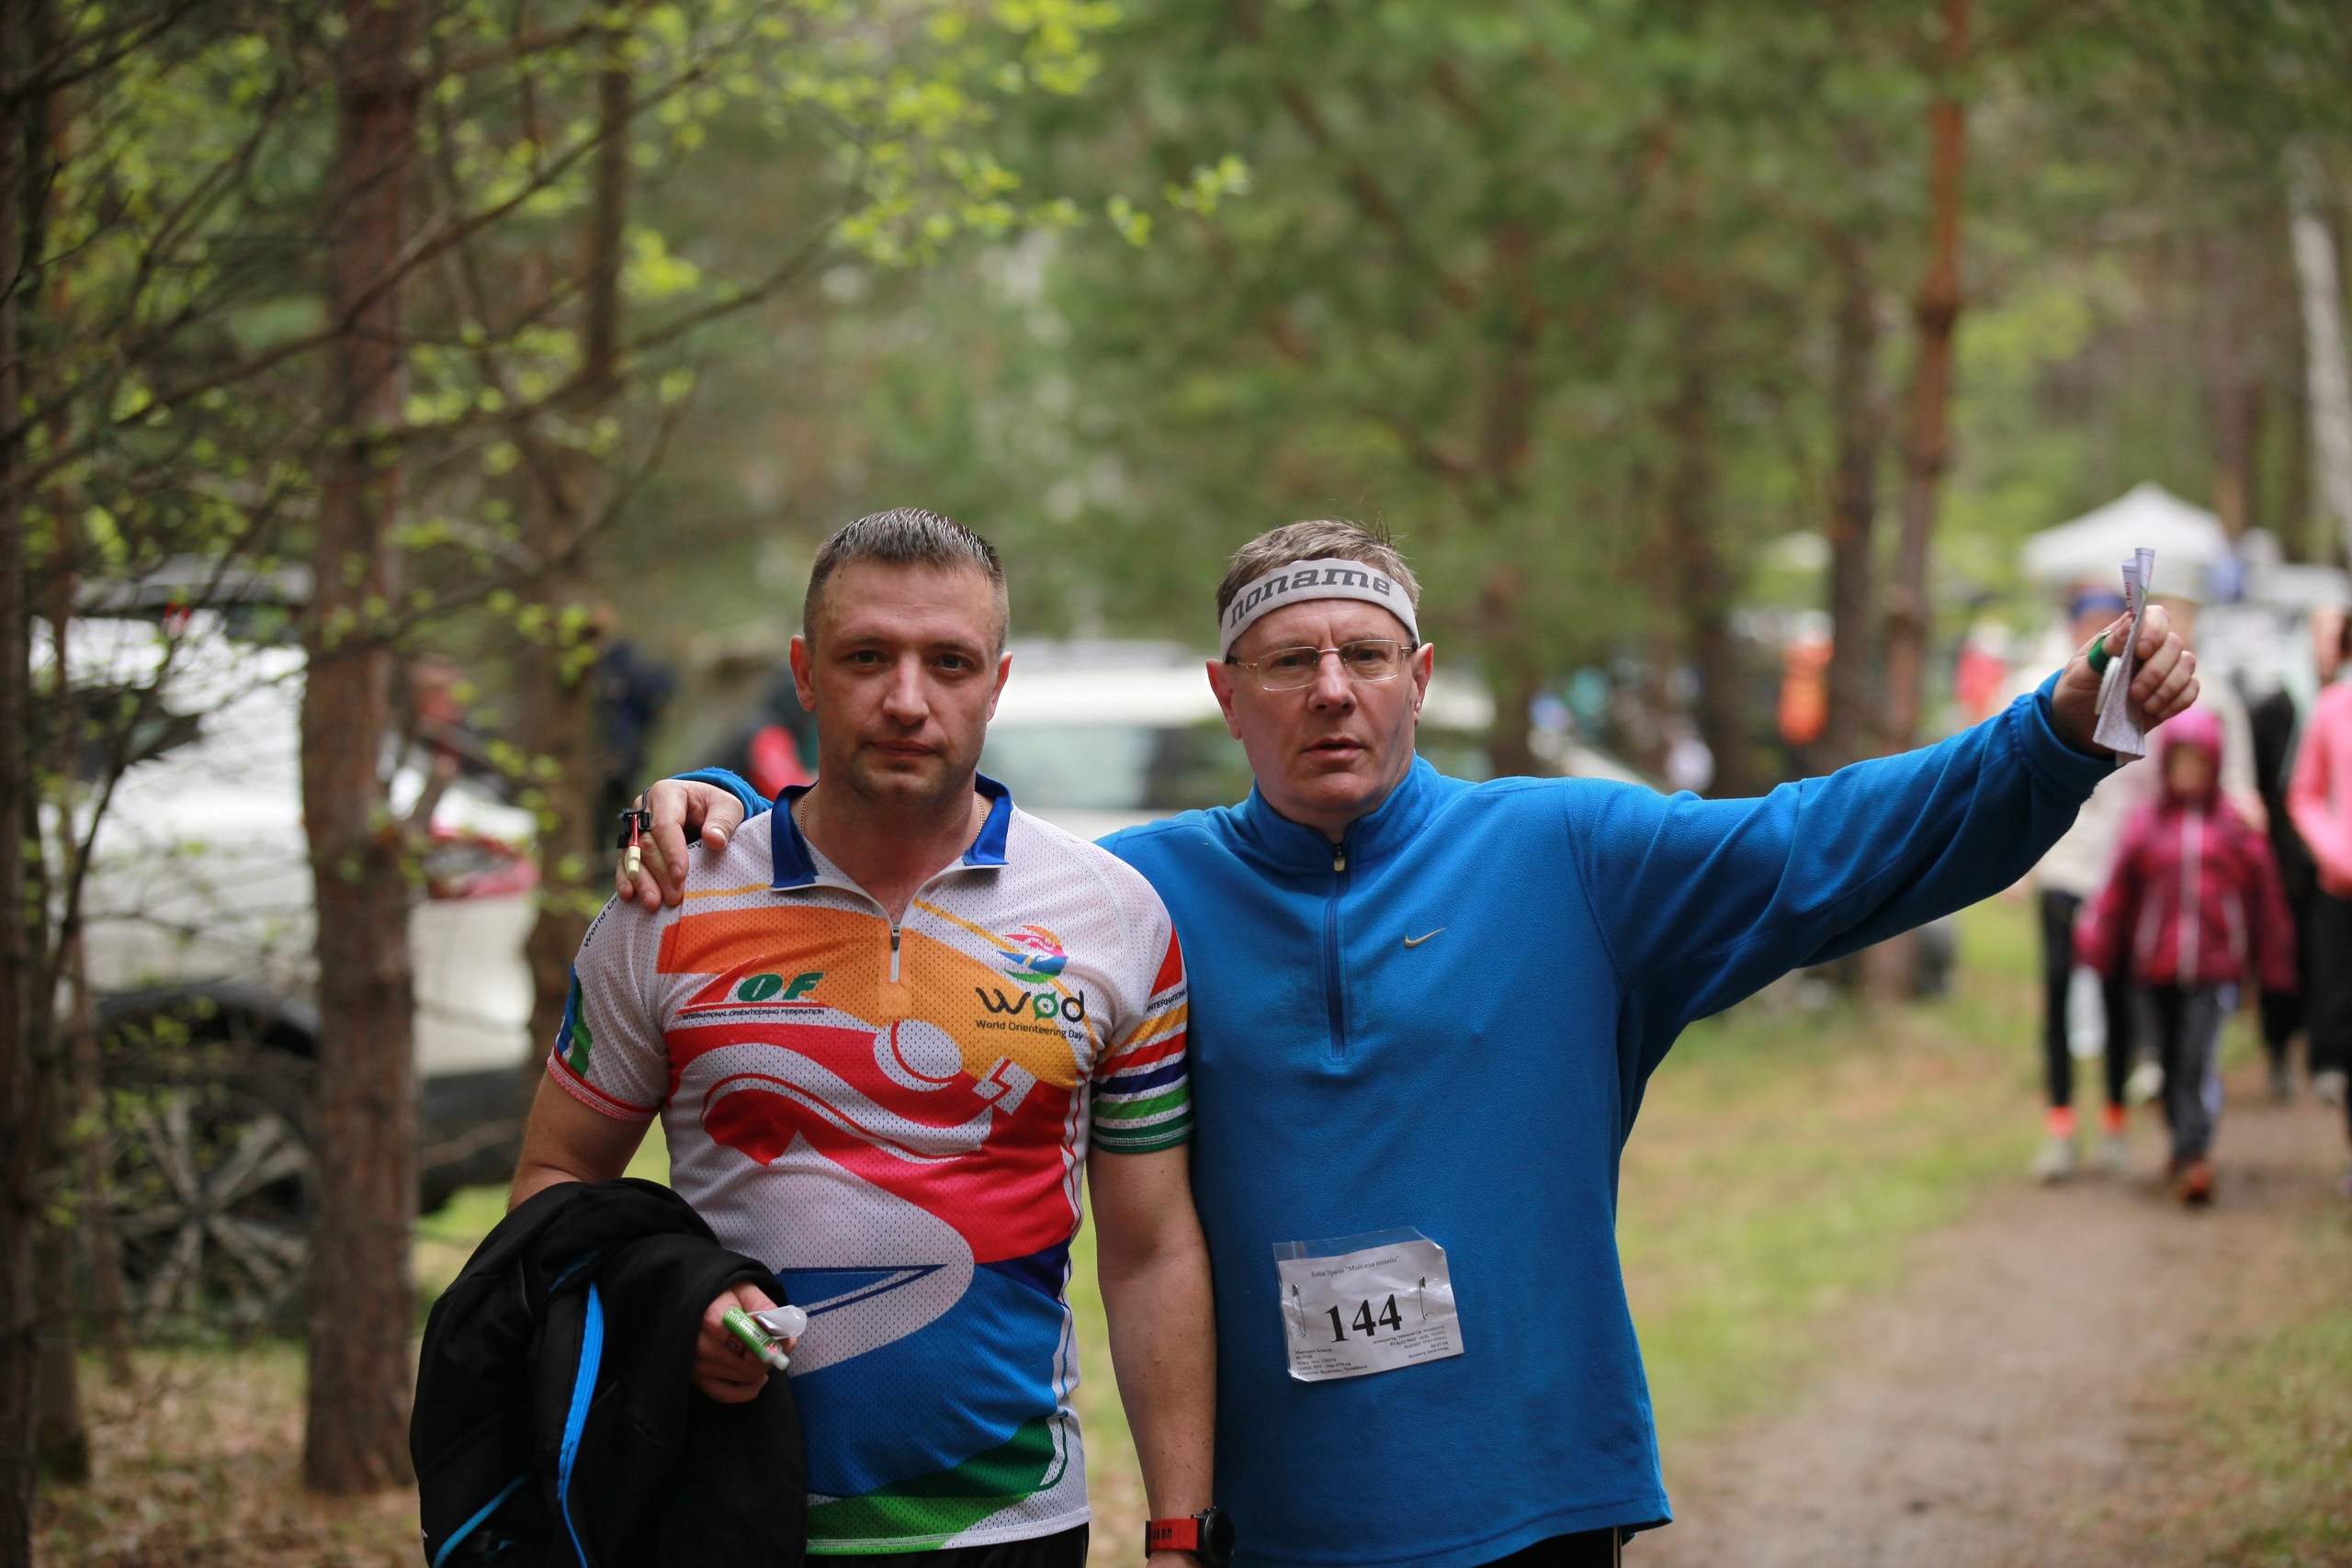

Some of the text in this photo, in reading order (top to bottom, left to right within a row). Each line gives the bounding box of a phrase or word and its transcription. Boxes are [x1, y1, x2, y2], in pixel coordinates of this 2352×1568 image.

[1230, 568, 1390, 628] noname
[583, 911, 606, 947] World
[683, 1010, 728, 1021] INTERNATIONAL
[729, 1009, 780, 1017] ORIENTEERING
[976, 1020, 1084, 1042] World Orienteering Day
[1327, 1269, 1344, 1277] Урала
[1325, 1293, 1402, 1343] 144
